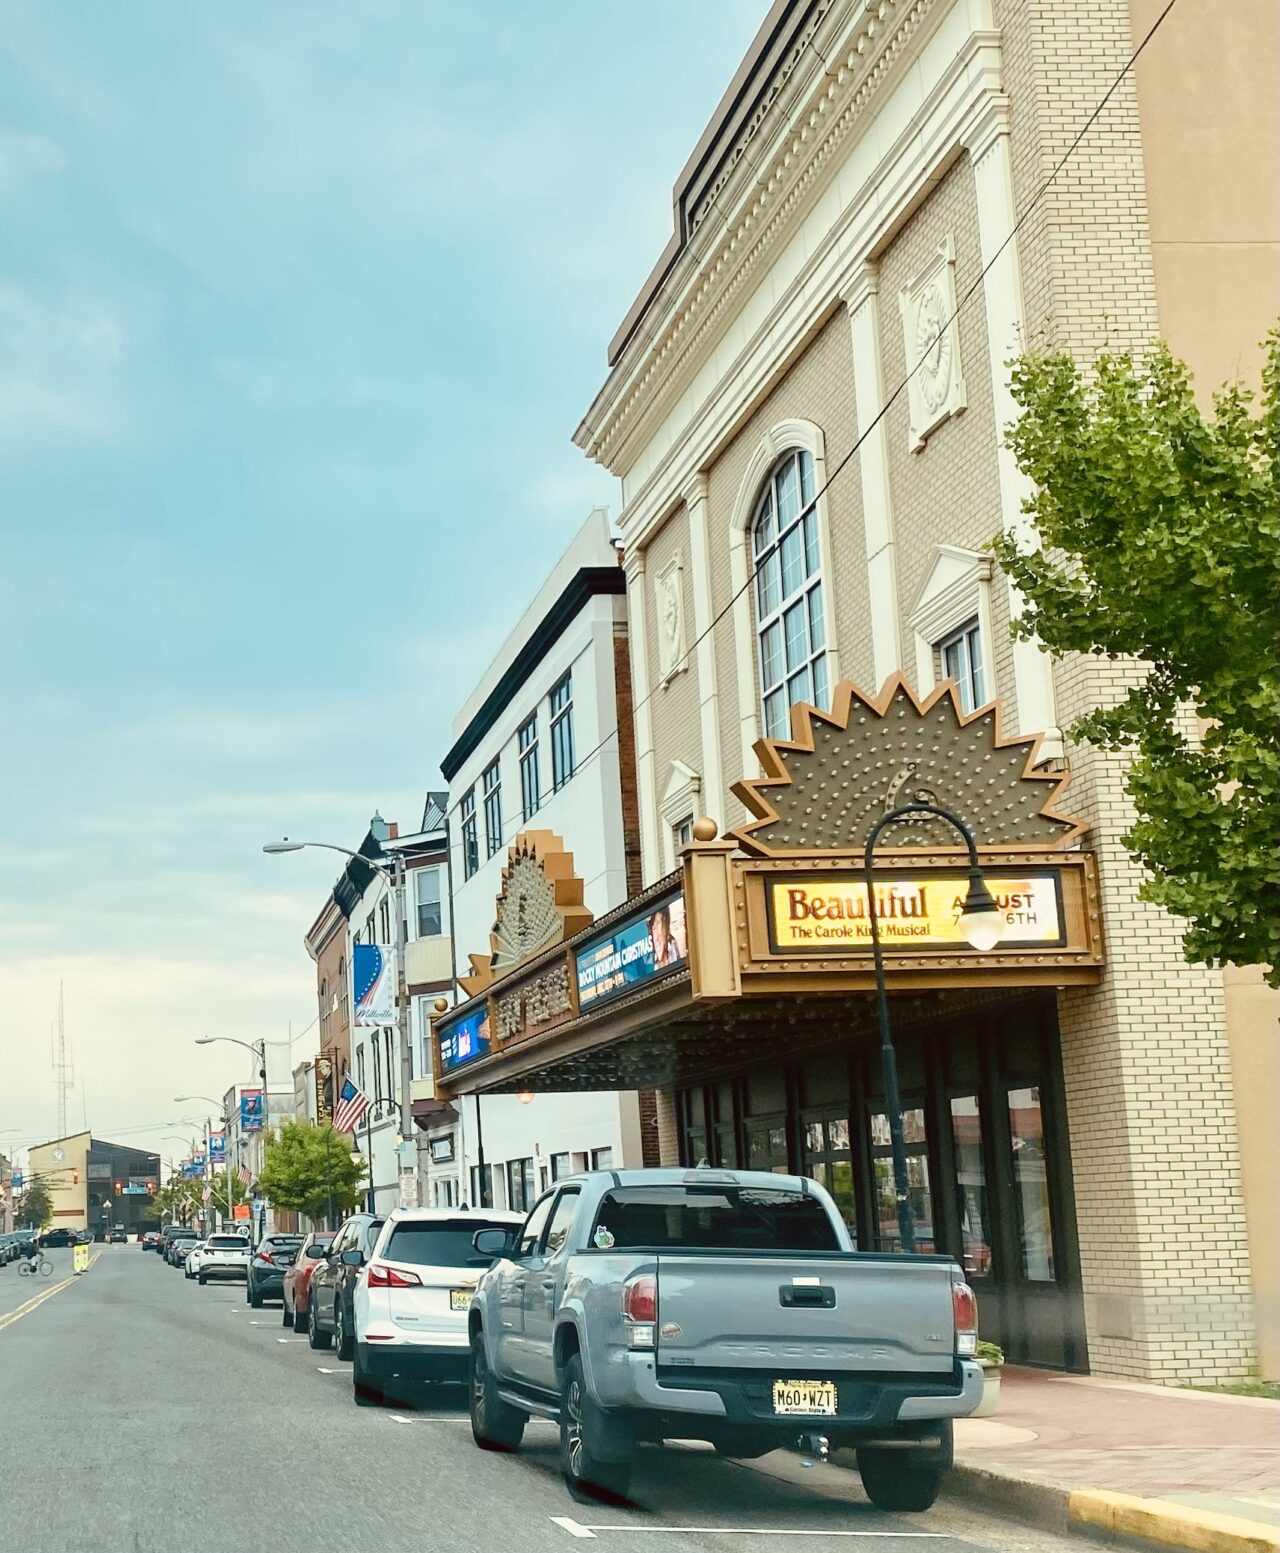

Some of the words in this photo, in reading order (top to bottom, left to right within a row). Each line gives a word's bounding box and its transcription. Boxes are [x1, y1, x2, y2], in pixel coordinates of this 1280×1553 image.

[787, 886, 928, 920] Beauiful
[952, 893, 1035, 911] AUST
[790, 926, 812, 938] The
[815, 924, 852, 938] Carole
[886, 923, 931, 937] Musical
[595, 951, 622, 980] MOUNTAIN
[622, 935, 654, 966] CHRISTMAS
[356, 1009, 394, 1018] Millville
[809, 1390, 832, 1407] WZT
